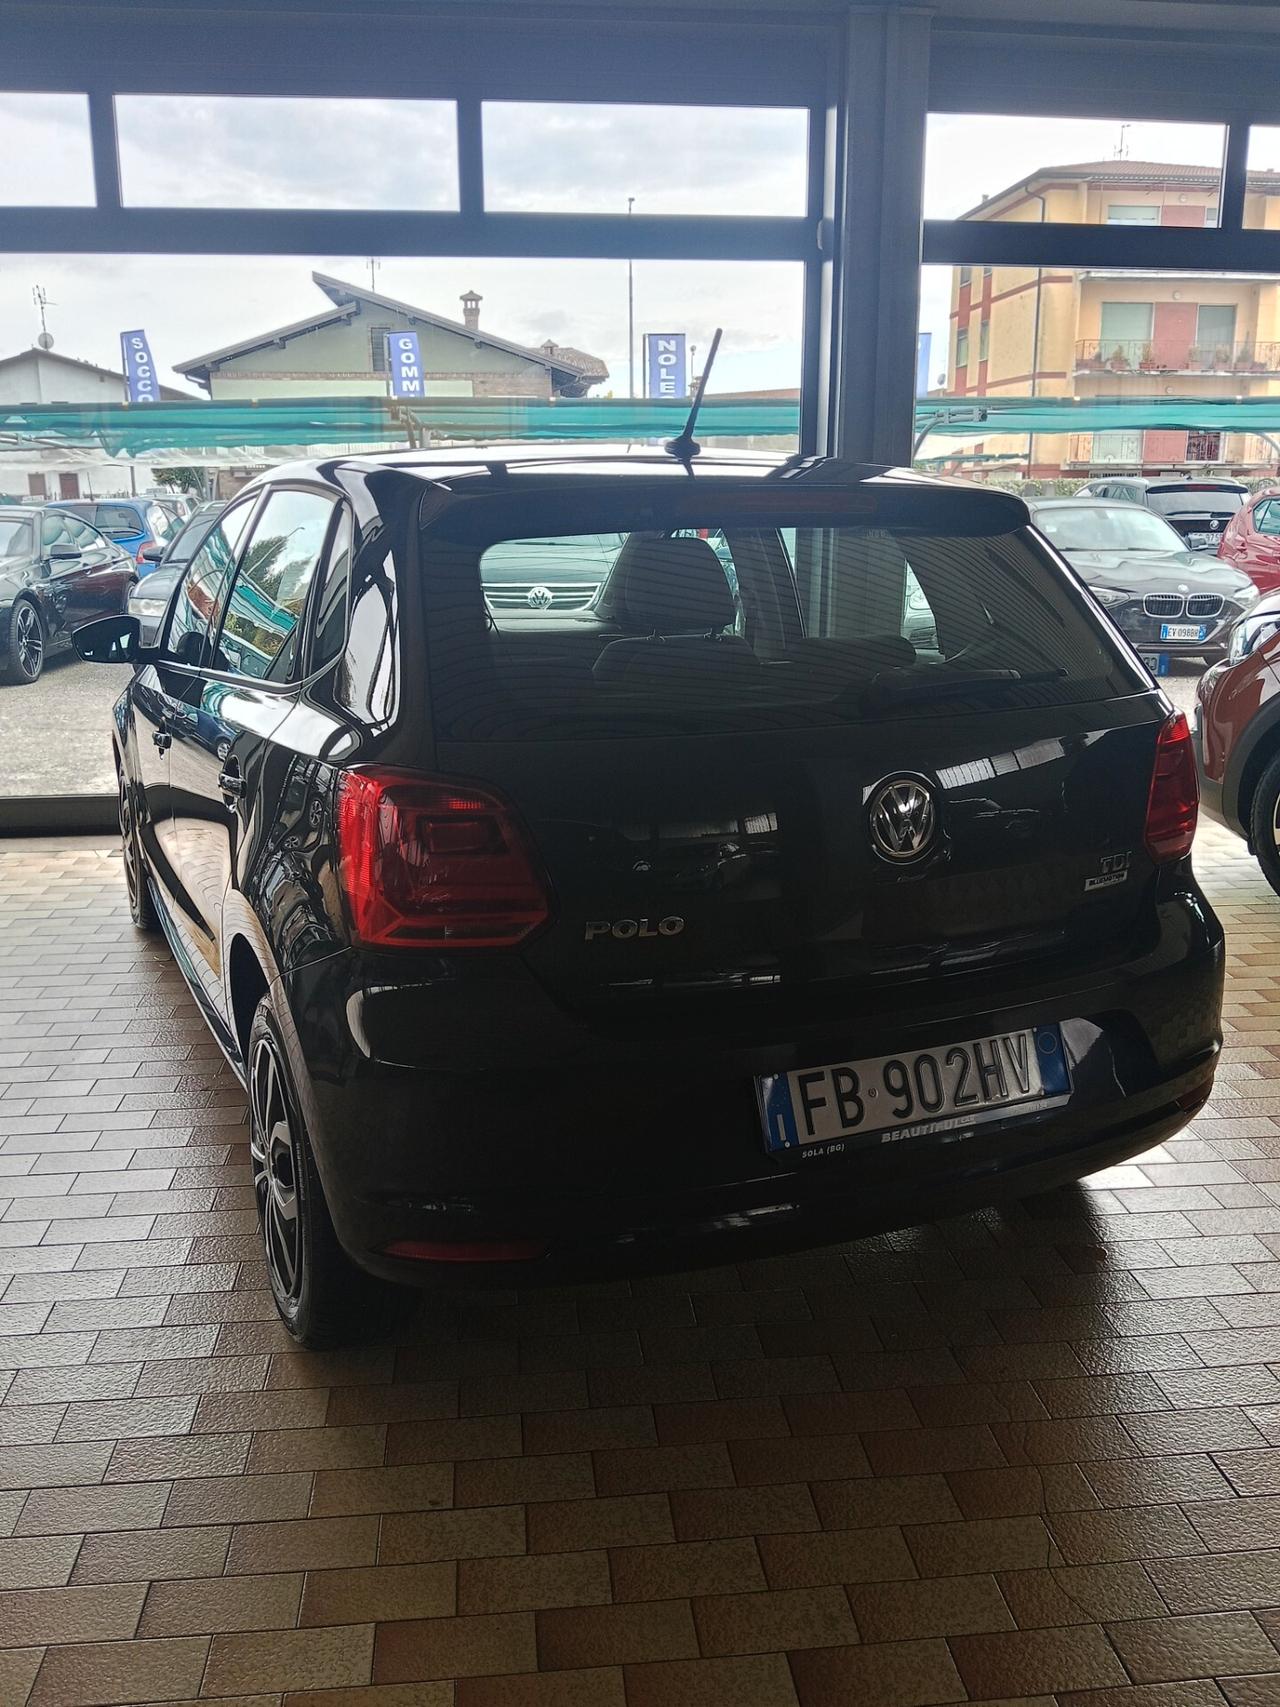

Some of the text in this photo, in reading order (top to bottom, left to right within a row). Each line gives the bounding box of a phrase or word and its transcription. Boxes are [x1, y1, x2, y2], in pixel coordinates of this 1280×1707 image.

[399, 338, 420, 398] GOMM
[658, 340, 676, 399] NOLE
[1101, 851, 1132, 873] TDI
[585, 916, 684, 941] POLO
[798, 1067, 866, 1136] FB
[883, 1034, 1030, 1119] 902HV
[802, 1143, 845, 1158] SOLA (BG)
